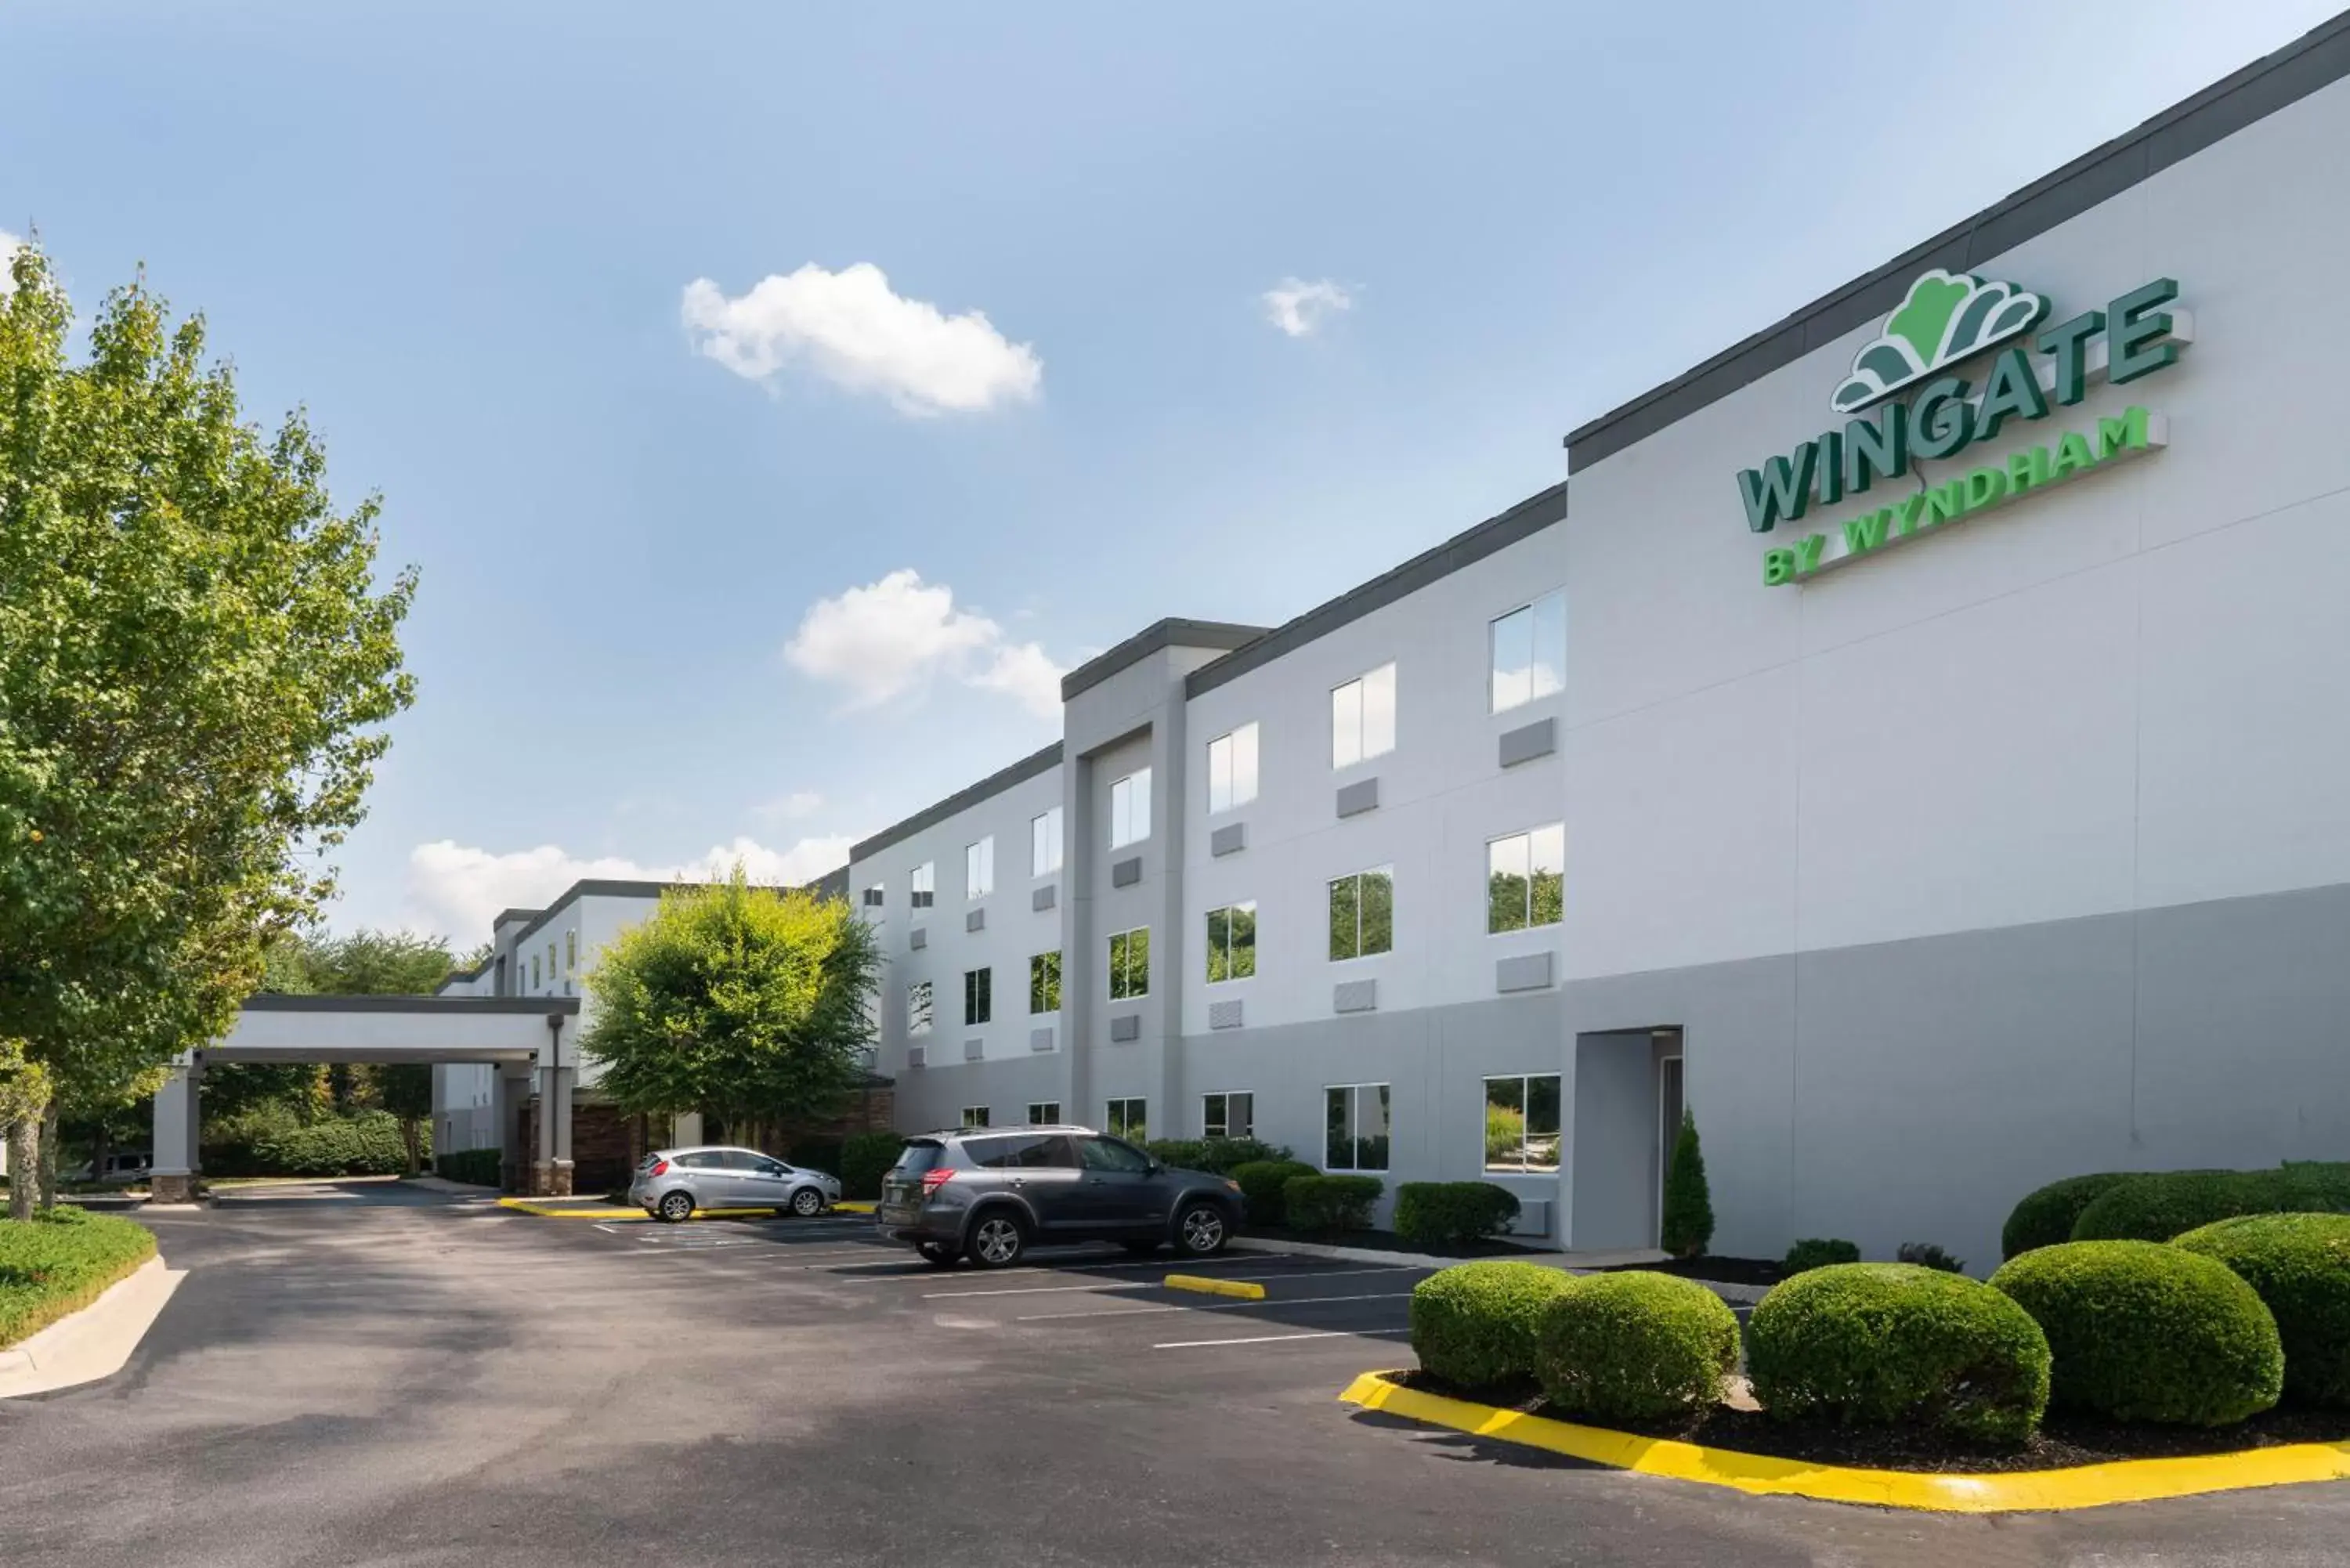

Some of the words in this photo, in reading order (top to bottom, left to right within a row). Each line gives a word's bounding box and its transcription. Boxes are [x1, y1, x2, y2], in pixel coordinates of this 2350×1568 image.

[1737, 276, 2179, 533] WINGATE
[1763, 533, 1826, 587] BY
[1842, 405, 2150, 554] WYNDHAM
